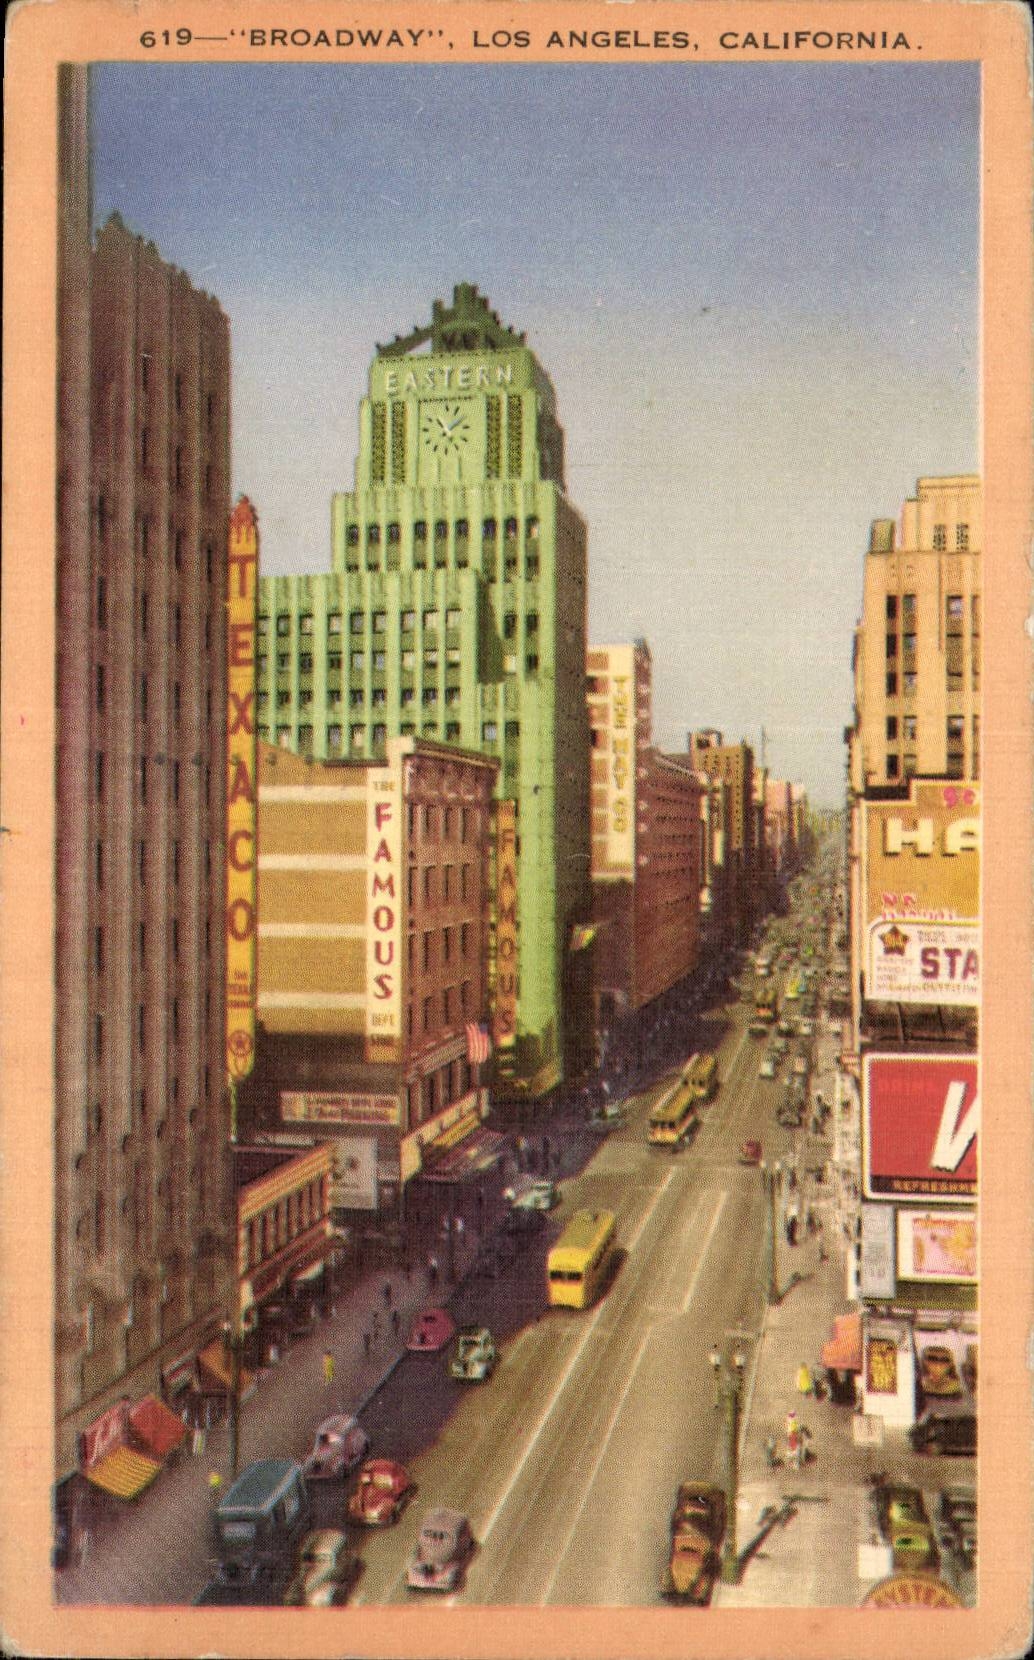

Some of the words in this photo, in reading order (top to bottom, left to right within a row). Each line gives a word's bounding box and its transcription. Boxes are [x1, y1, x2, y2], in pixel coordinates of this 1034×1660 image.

[385, 363, 513, 394] EASTERN
[228, 553, 256, 942] TEXACO
[371, 802, 396, 1000] FAMOUS
[502, 828, 516, 1035] FAMOUS
